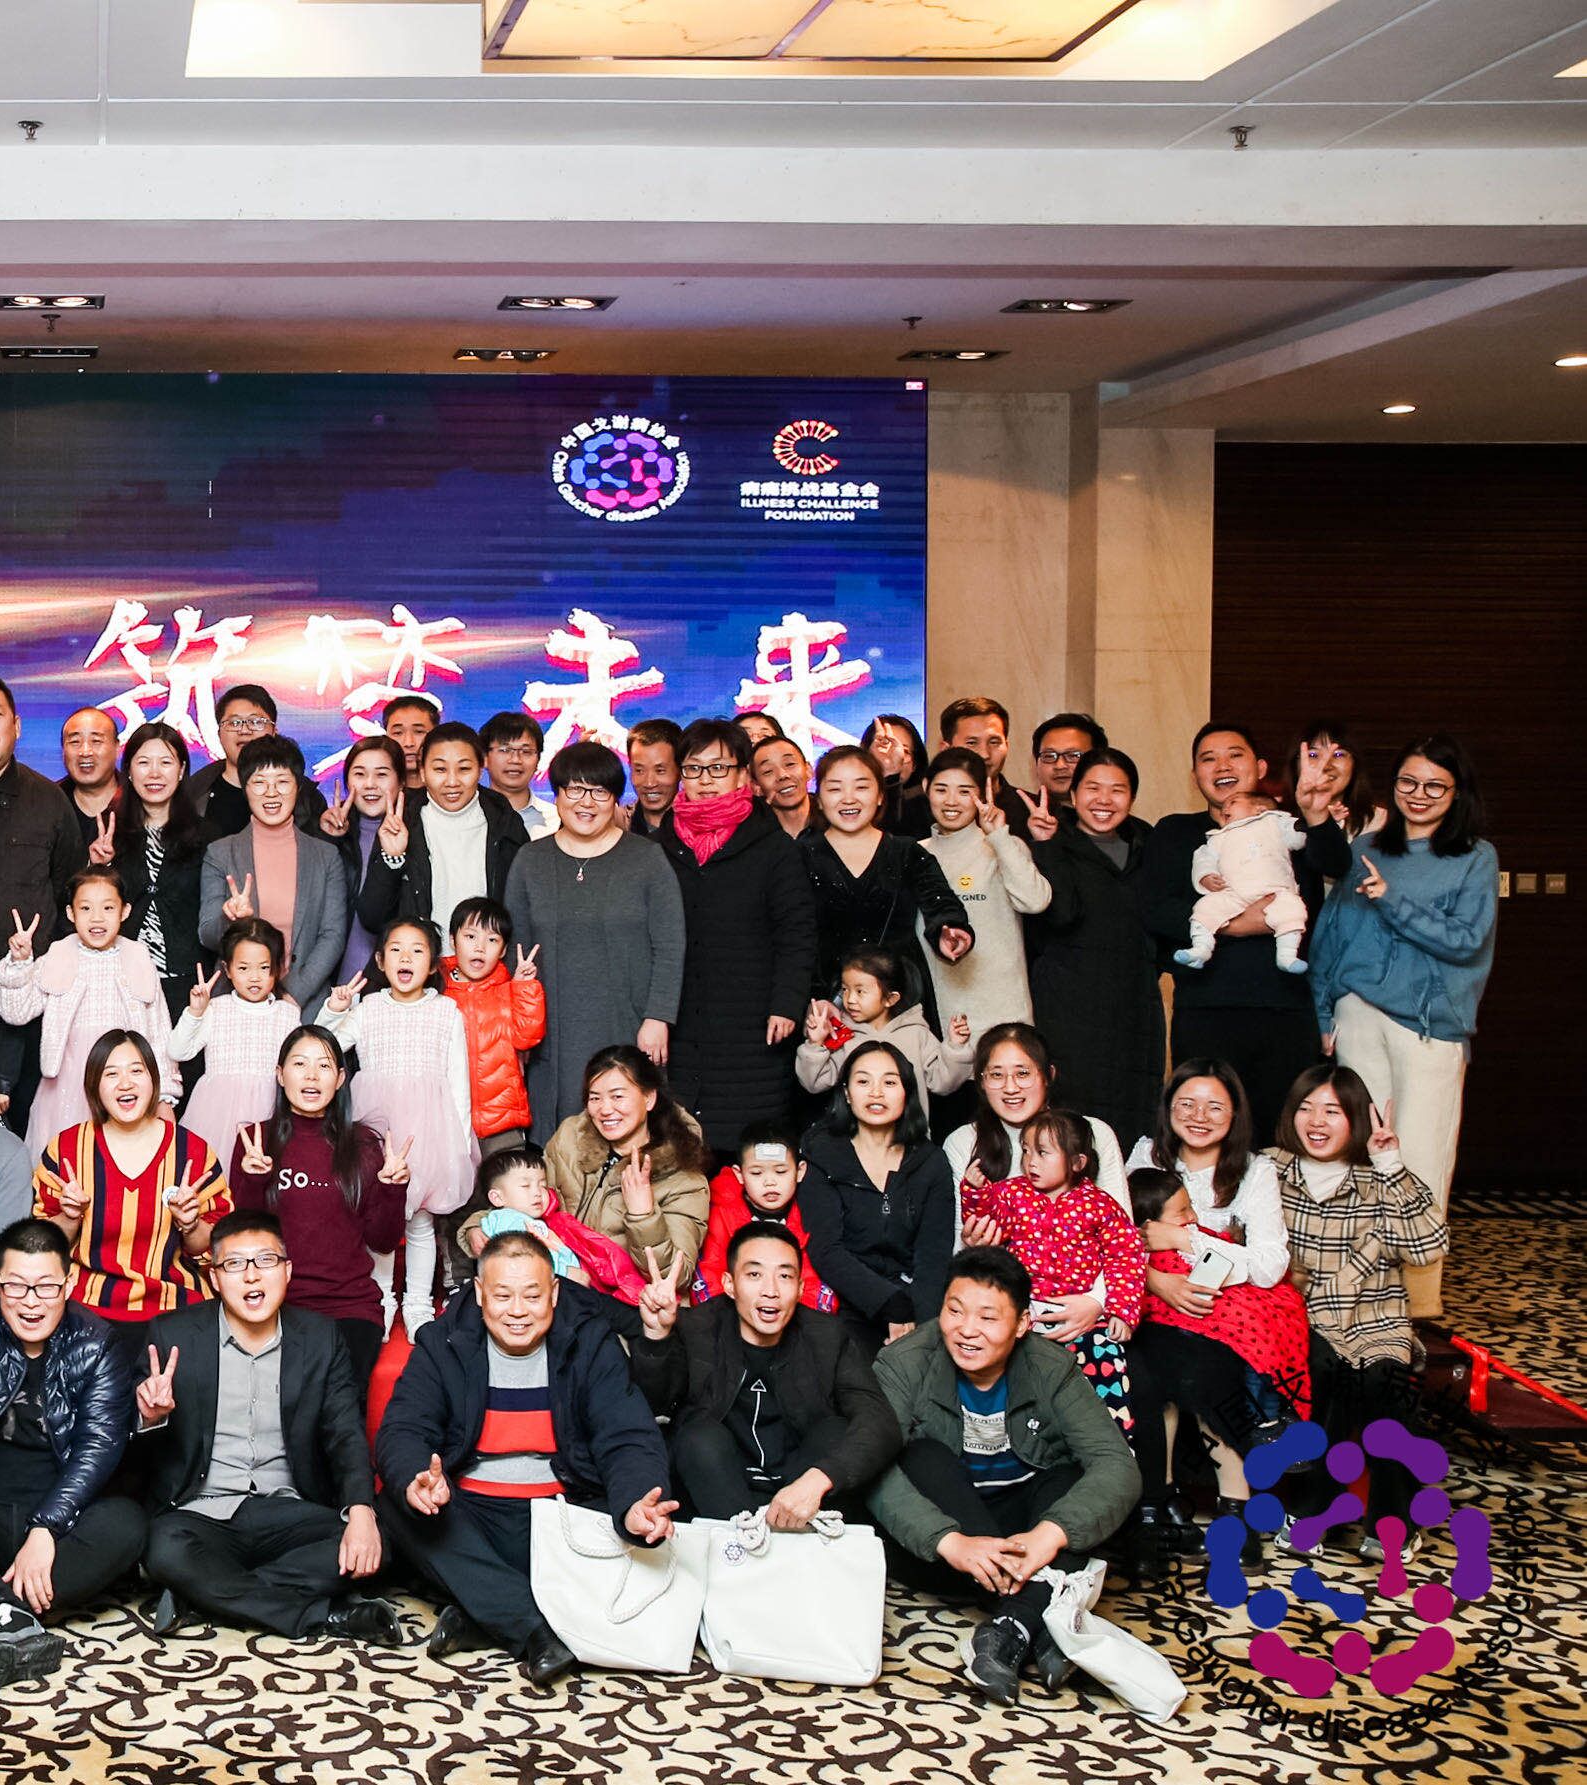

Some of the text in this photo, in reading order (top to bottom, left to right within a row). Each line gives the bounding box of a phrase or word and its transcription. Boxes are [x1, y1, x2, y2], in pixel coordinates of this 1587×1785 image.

[560, 414, 680, 450] 中国戈谢病协会
[552, 450, 569, 483] China
[557, 483, 605, 518] Gaucher
[740, 498, 879, 509] ILLNESS CHALLENGE
[605, 506, 660, 522] disease
[764, 510, 855, 521] FOUNDATION
